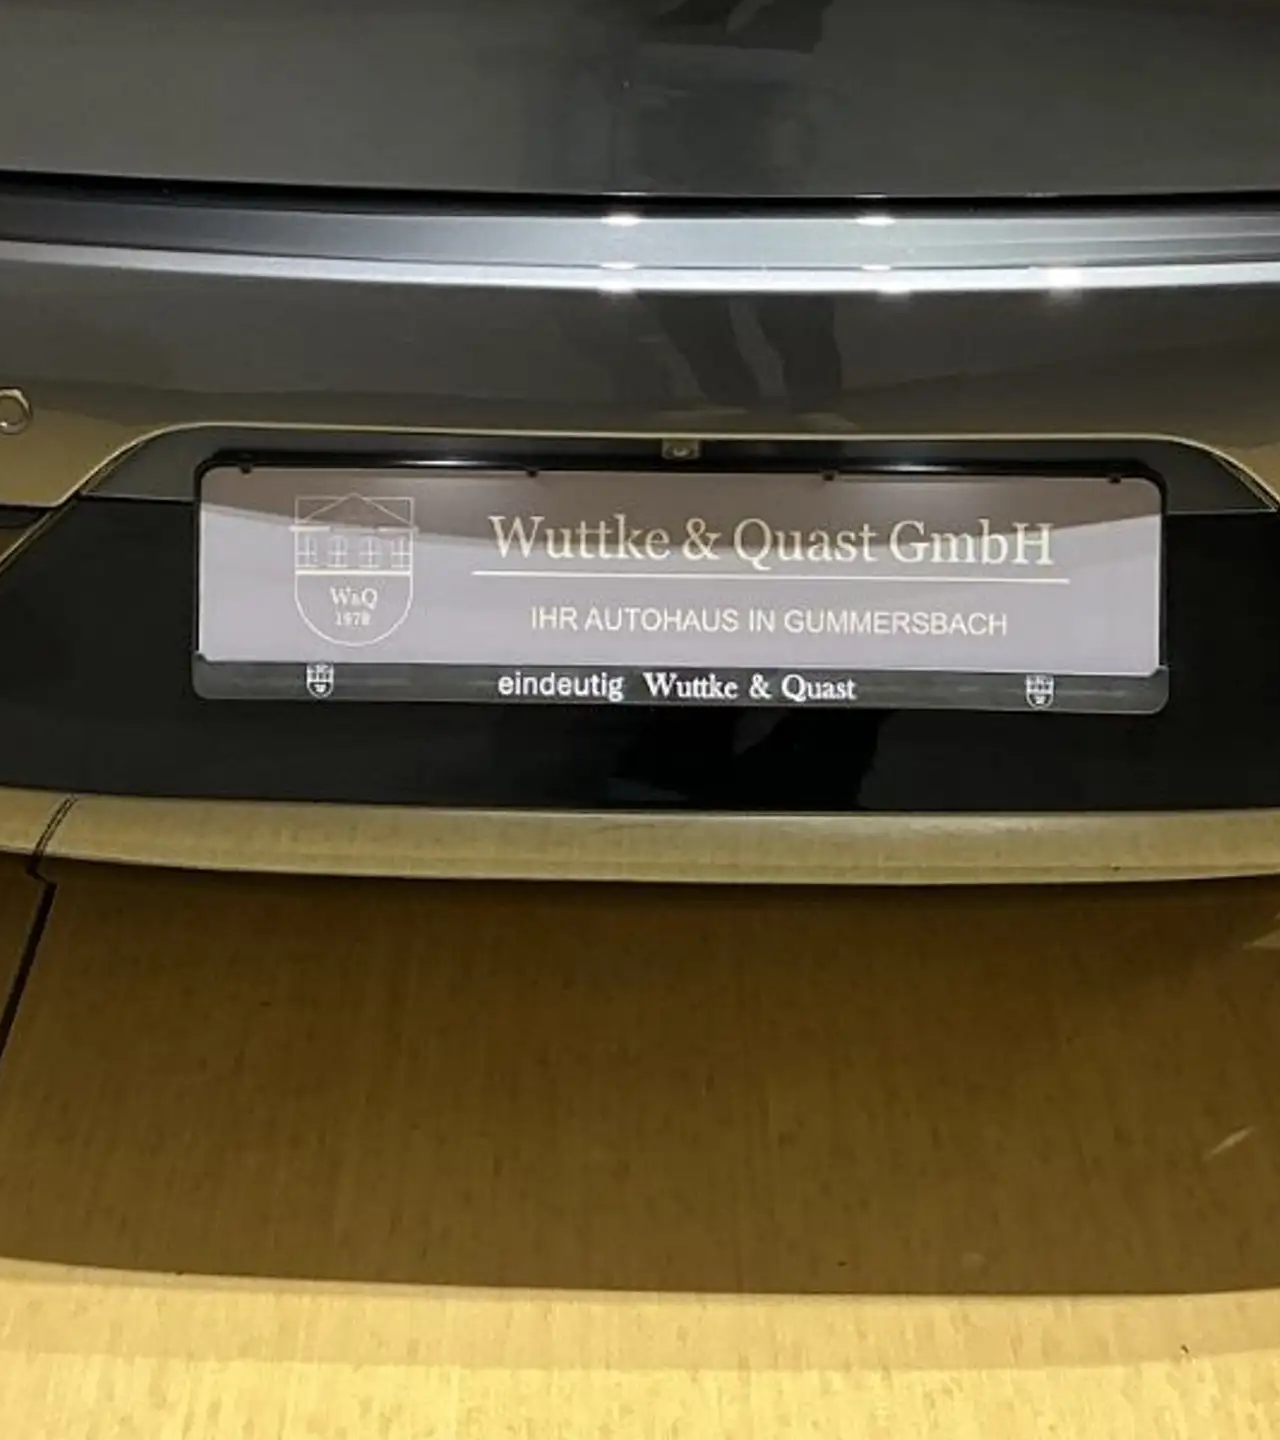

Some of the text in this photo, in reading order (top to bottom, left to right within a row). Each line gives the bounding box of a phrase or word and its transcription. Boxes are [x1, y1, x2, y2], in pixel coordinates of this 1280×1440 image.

[487, 512, 1055, 571] Wuttke & Quast GmbH
[531, 606, 1008, 637] IHR AUTOHAUS IN GUMMERSBACH
[497, 671, 857, 703] eindeutig Wuttke & Quast
